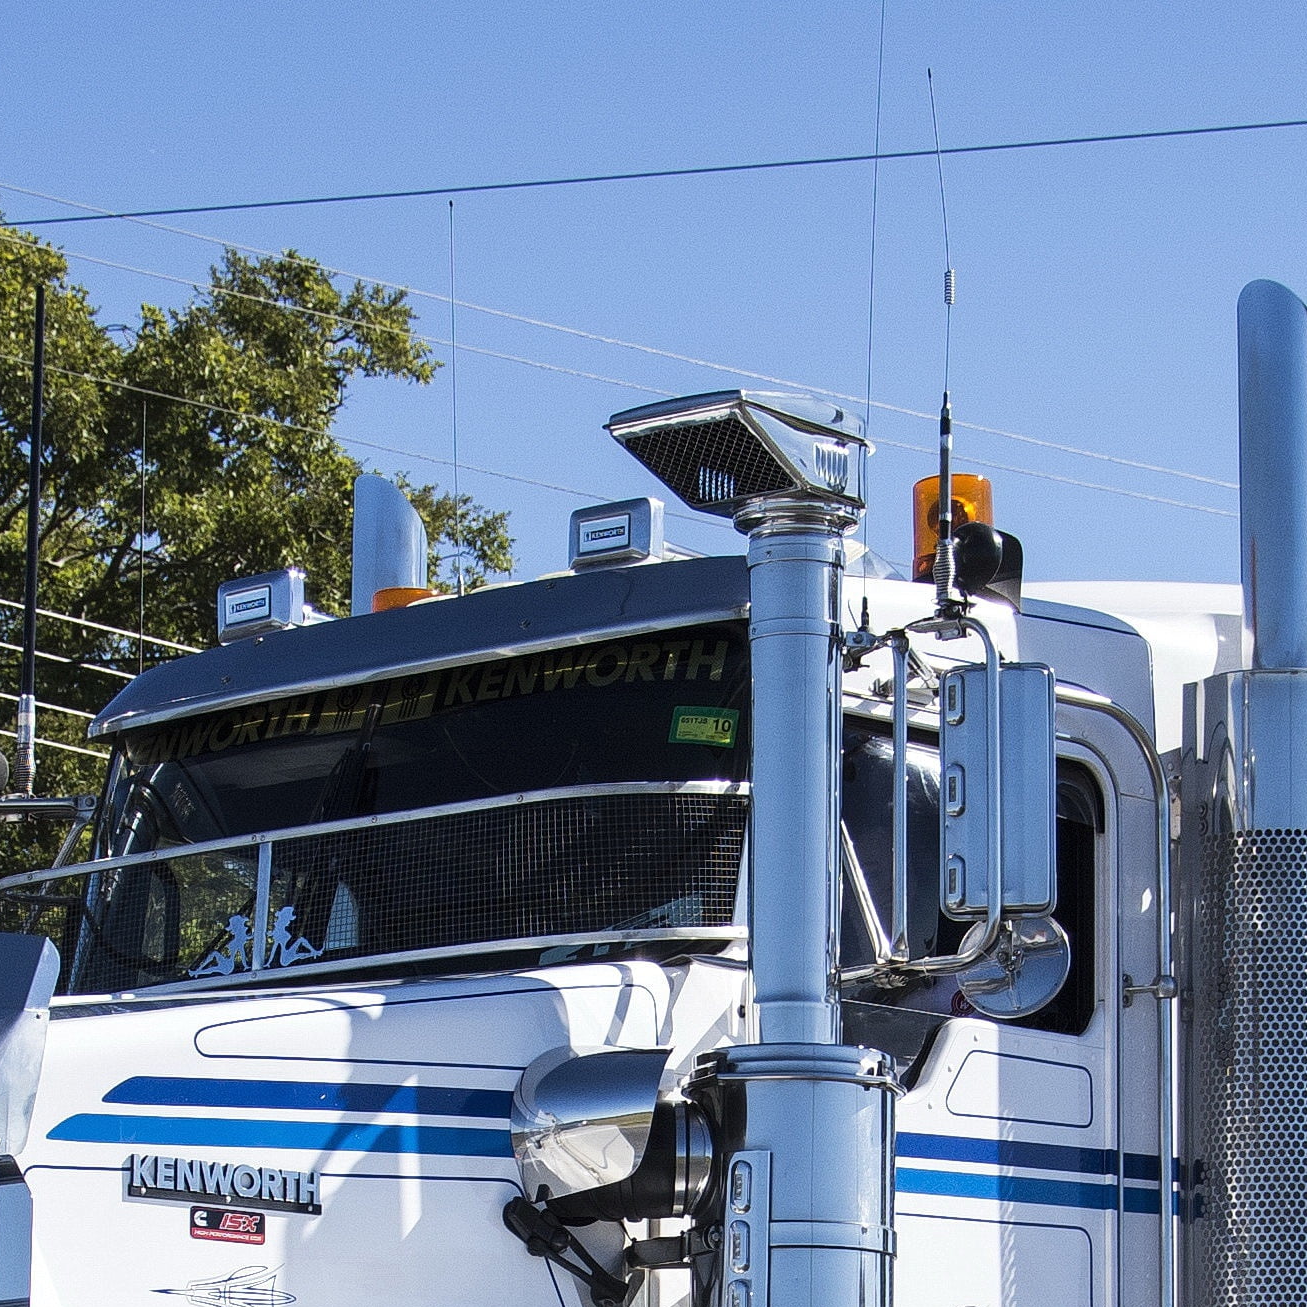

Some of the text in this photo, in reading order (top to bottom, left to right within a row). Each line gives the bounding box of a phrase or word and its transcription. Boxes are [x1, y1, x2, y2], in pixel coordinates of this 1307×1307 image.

[445, 640, 729, 706] KENWORTH
[713, 718, 732, 733] 10
[131, 1153, 321, 1205] KENWORTH
[219, 1212, 261, 1233] ISX
